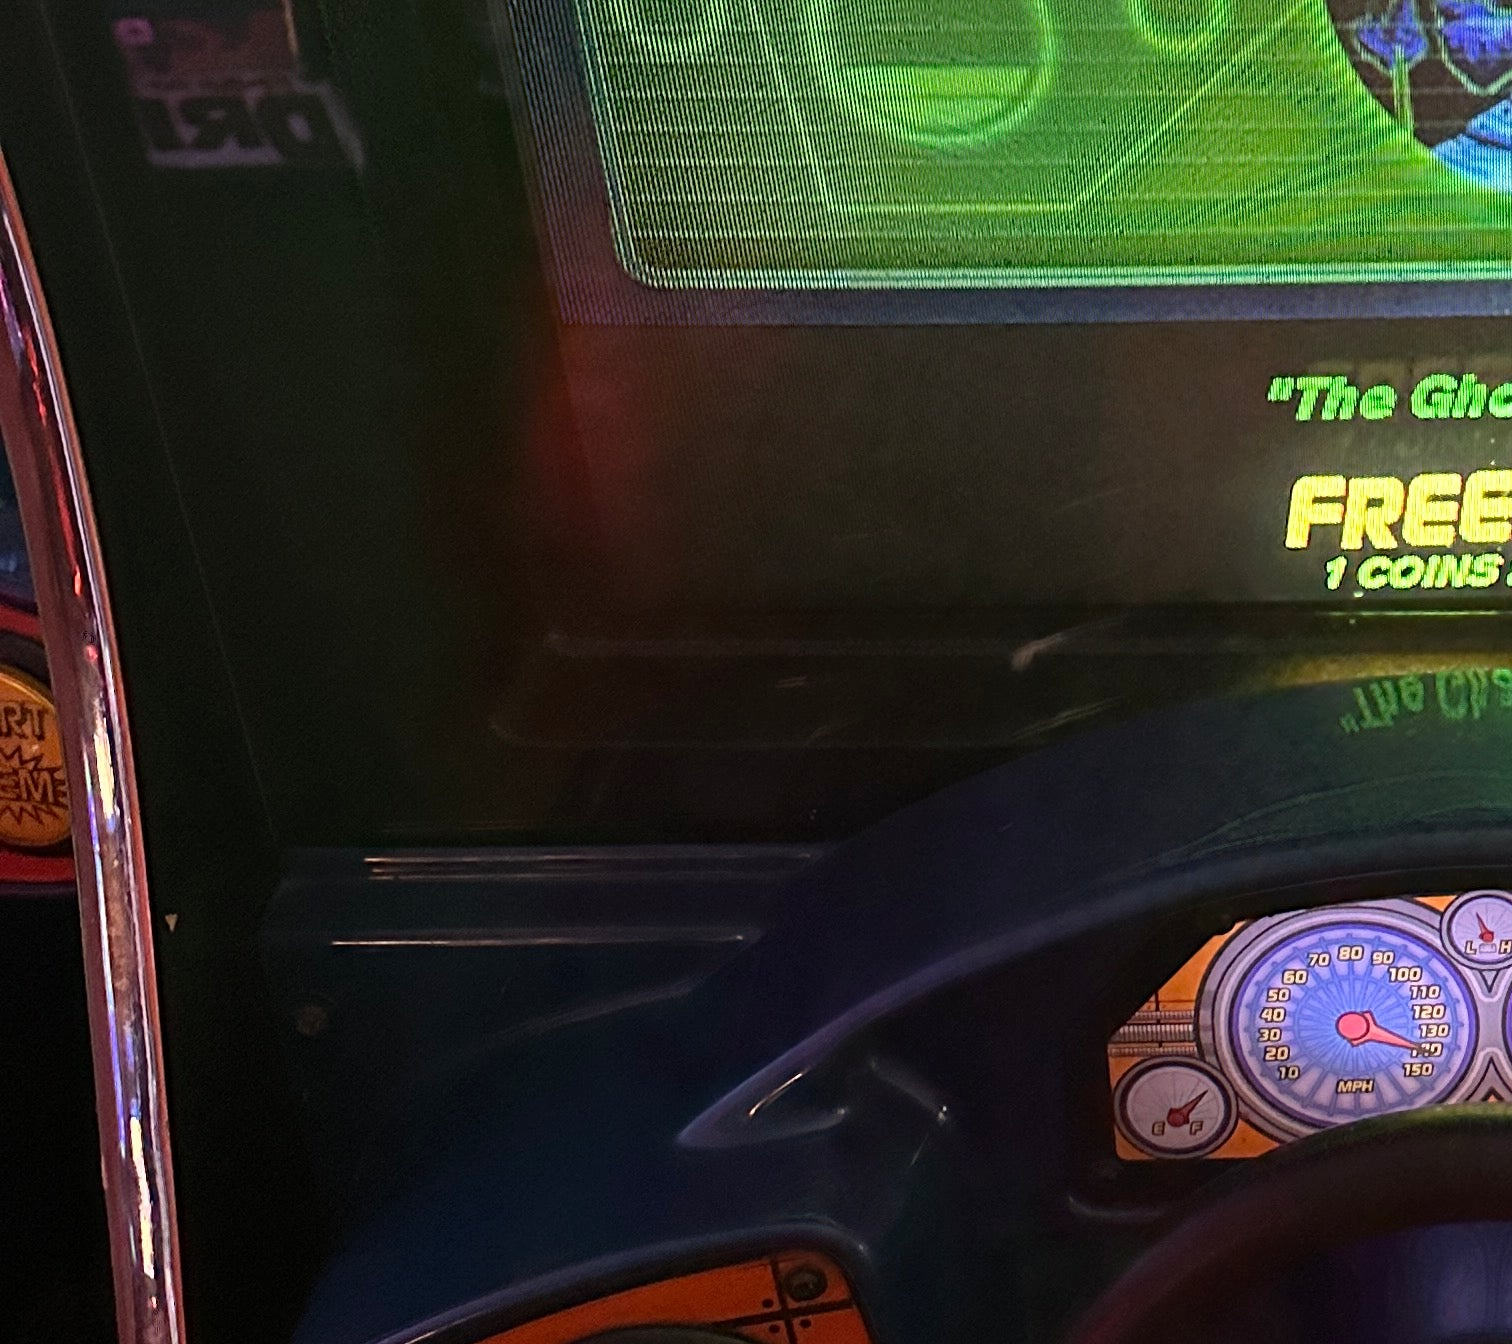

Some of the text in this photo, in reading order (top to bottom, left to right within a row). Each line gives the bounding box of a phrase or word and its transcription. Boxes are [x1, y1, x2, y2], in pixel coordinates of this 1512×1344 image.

[1267, 375, 1397, 421] "The
[1324, 555, 1347, 589] 1
[1356, 552, 1504, 589] COINS
[1306, 952, 1331, 968] 70
[1338, 945, 1364, 962] 80
[1371, 950, 1395, 966] 90
[1281, 969, 1308, 986] 60
[1388, 966, 1423, 983] 100
[1266, 987, 1290, 1003] 50
[1410, 984, 1441, 1000] 110
[1259, 1007, 1285, 1023] 40
[1412, 1003, 1446, 1020] 120
[1257, 1027, 1281, 1042] 30
[1419, 1023, 1450, 1039] 130
[1264, 1045, 1290, 1062] 20
[1278, 1065, 1300, 1080] 10
[1403, 1061, 1434, 1077] 150
[1336, 1078, 1375, 1094] MPH
[1151, 1120, 1204, 1136] E F
